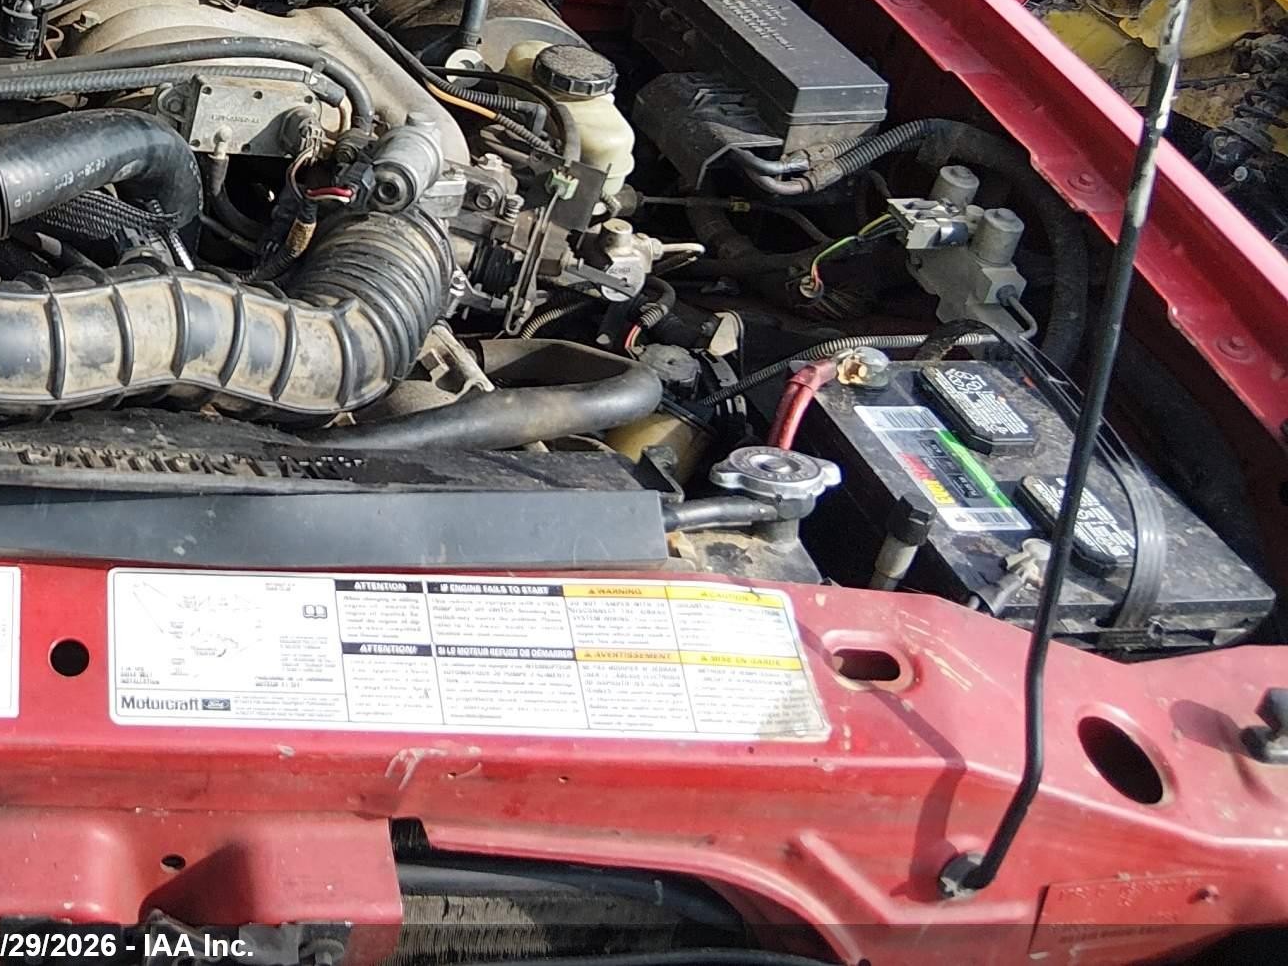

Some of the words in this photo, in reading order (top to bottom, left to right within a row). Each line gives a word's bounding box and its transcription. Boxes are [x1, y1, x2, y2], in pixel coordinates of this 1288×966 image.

[508, 585, 520, 594] TO
[521, 586, 549, 595] START
[597, 588, 642, 596] WARNING
[593, 651, 672, 661] AVERTISSEMENT
[121, 695, 199, 711] Motorcraft
